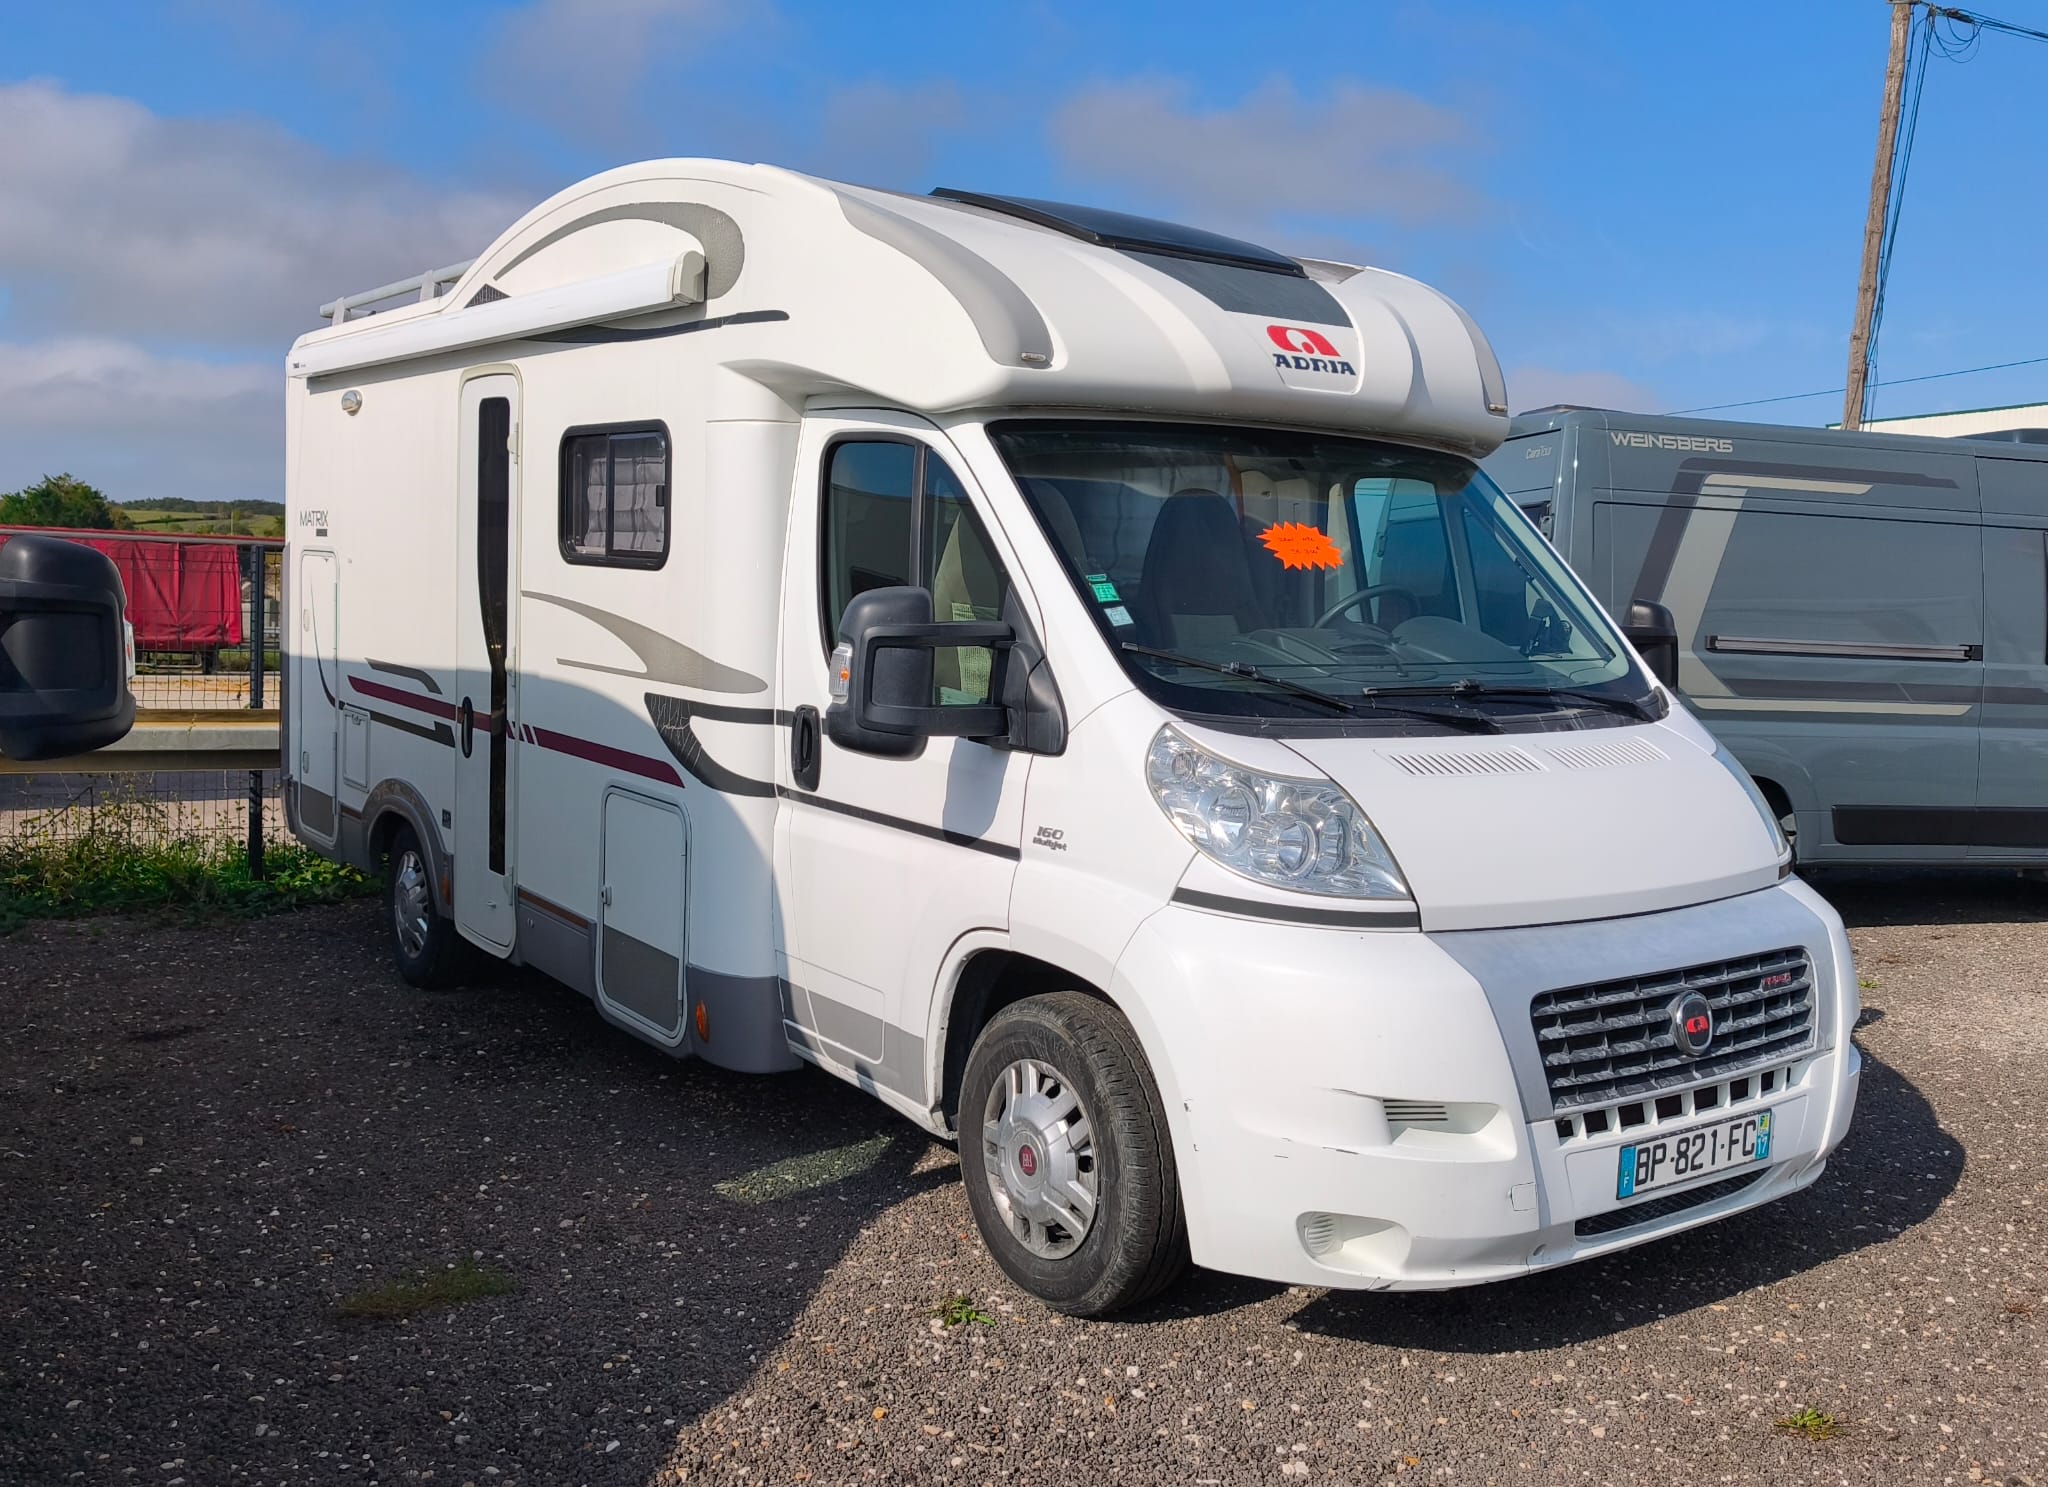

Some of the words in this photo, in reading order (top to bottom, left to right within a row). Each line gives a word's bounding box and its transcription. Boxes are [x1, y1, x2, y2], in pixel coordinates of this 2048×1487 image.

[1272, 353, 1356, 376] ADRIA
[1610, 431, 1734, 453] WEINSBERG
[300, 510, 329, 527] MATRIX
[1036, 825, 1064, 840] 160
[1757, 1136, 1768, 1155] 17
